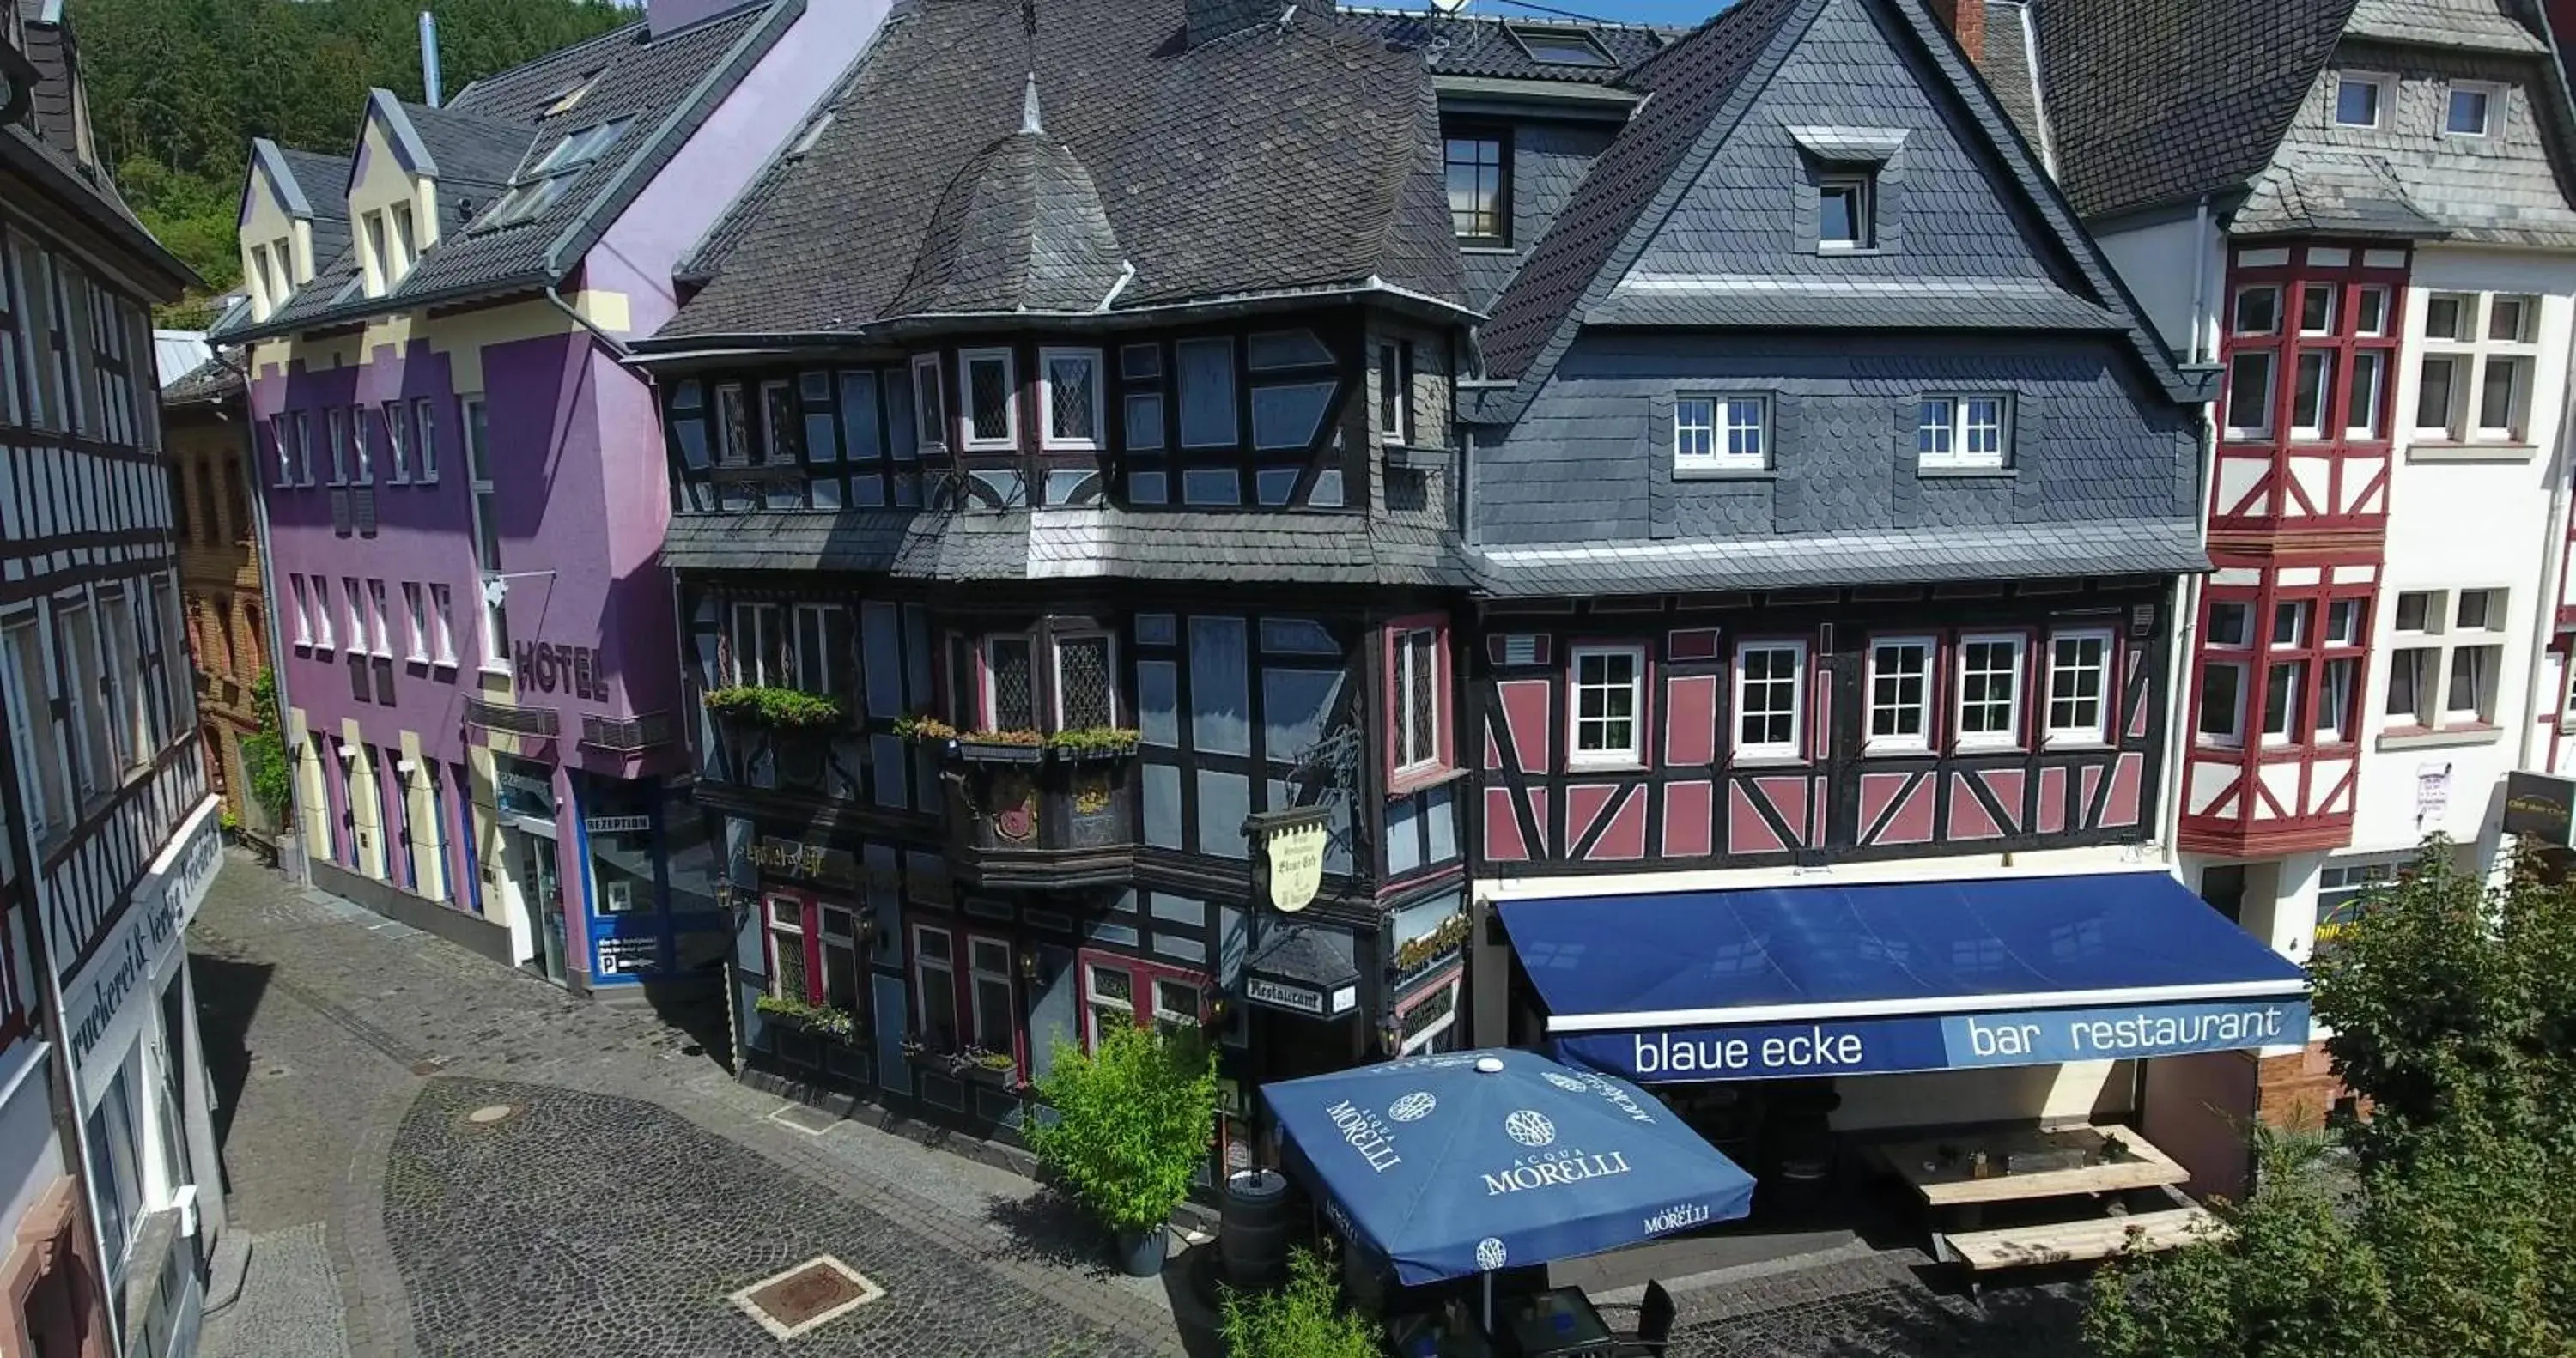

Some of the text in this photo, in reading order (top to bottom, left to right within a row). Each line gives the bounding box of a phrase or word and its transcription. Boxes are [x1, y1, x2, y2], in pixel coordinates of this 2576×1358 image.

[515, 640, 609, 704] HOTEL
[587, 816, 648, 830] REZEPTION
[71, 938, 137, 1072] ruckerei
[1635, 1025, 1862, 1073] blaue ecke
[1967, 1005, 2282, 1057] bar restaurant
[1326, 1100, 1401, 1173] MORELLI
[1514, 1149, 1585, 1167] ACQUA
[1480, 1150, 1632, 1196] MORELLI
[1643, 1204, 1710, 1234] MORELLI
